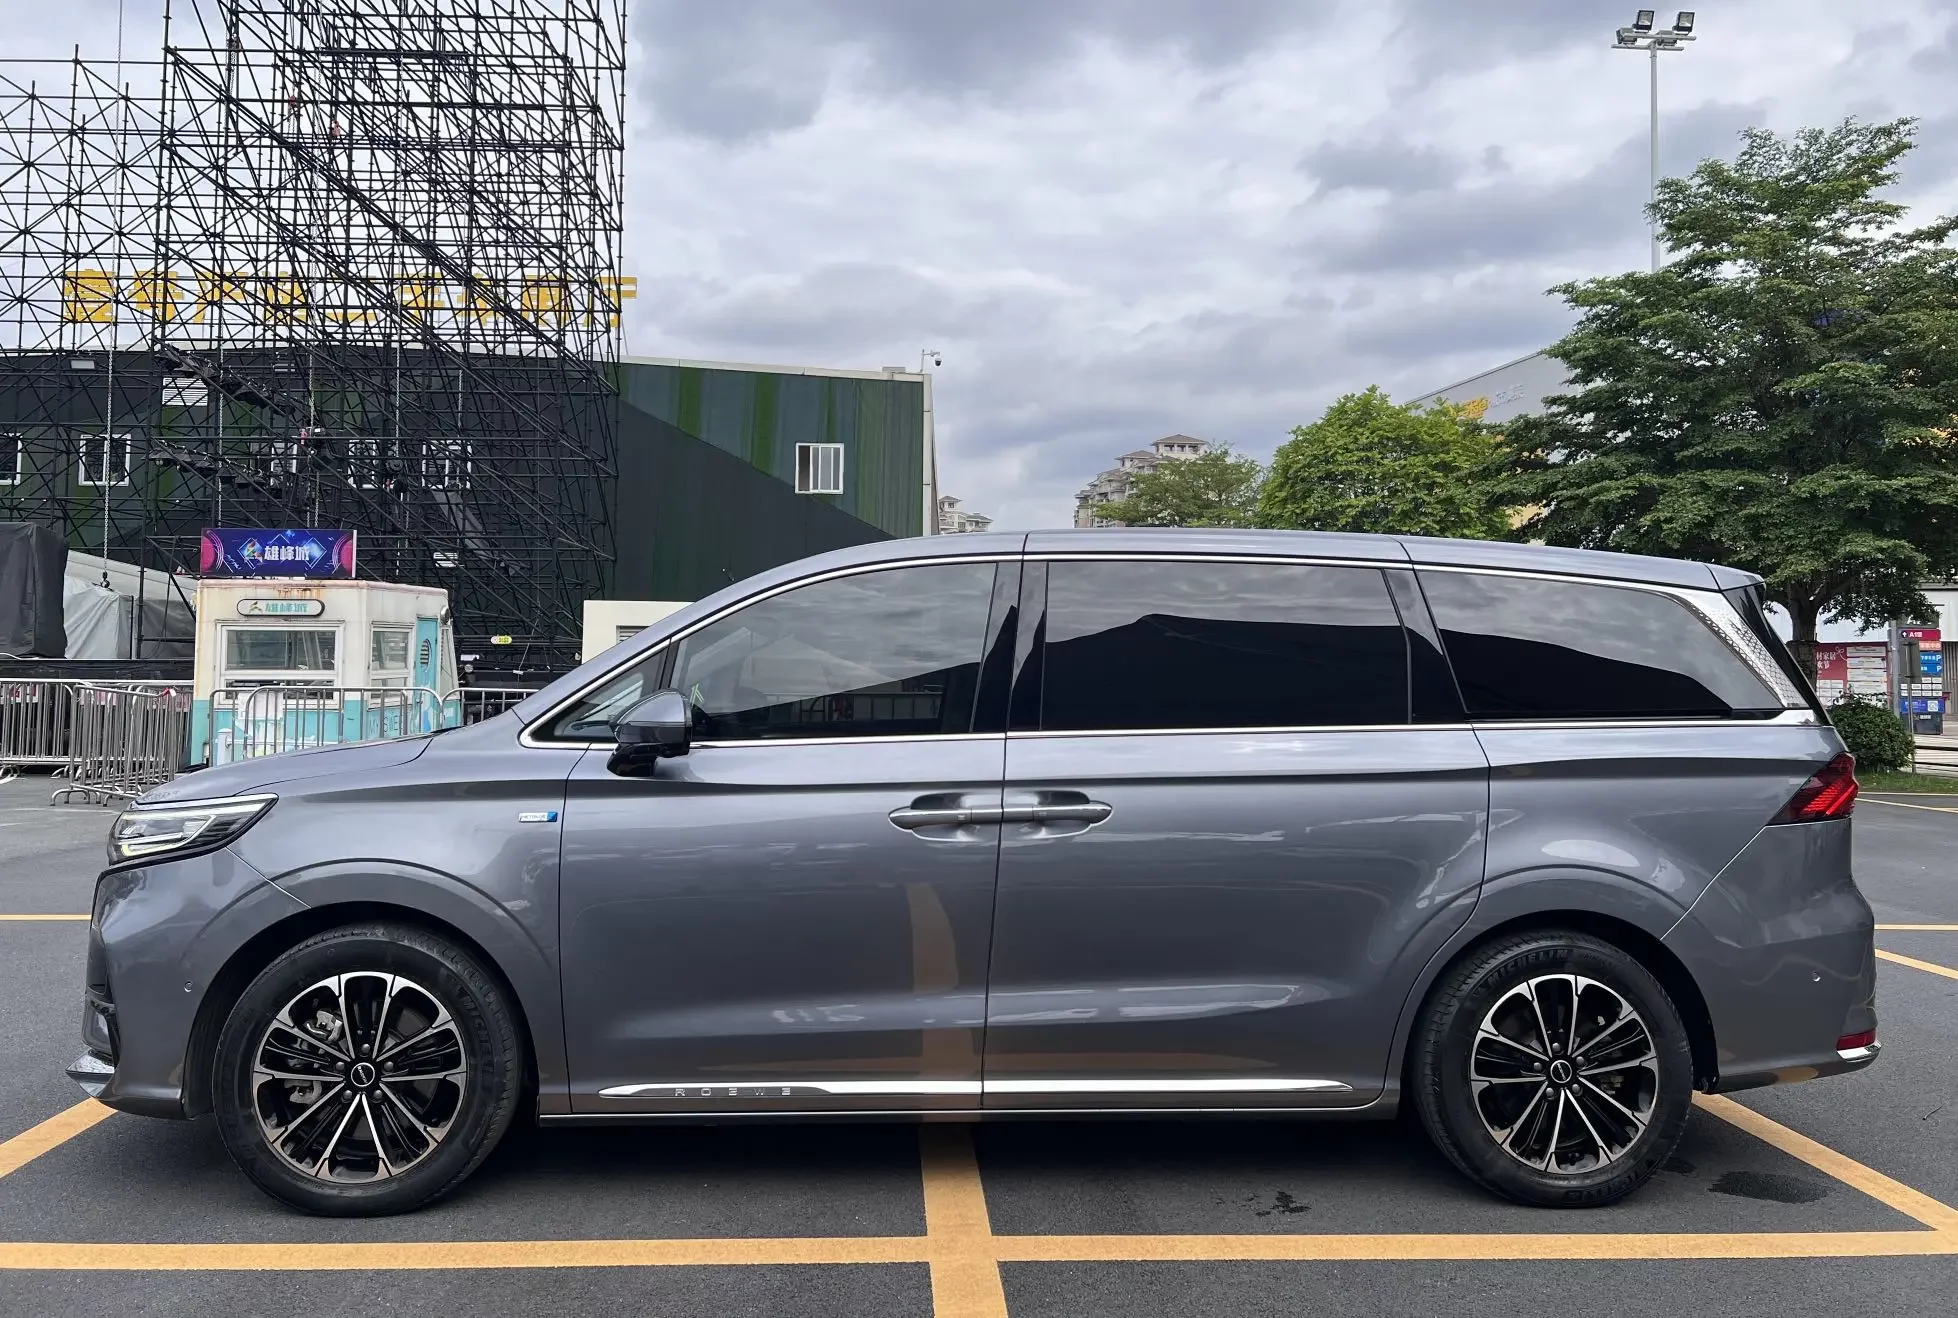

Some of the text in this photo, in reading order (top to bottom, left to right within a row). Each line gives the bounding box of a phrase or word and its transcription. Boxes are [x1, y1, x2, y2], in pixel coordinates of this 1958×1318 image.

[264, 545, 310, 561] 雄峰城
[674, 1087, 791, 1097] ROEWE
